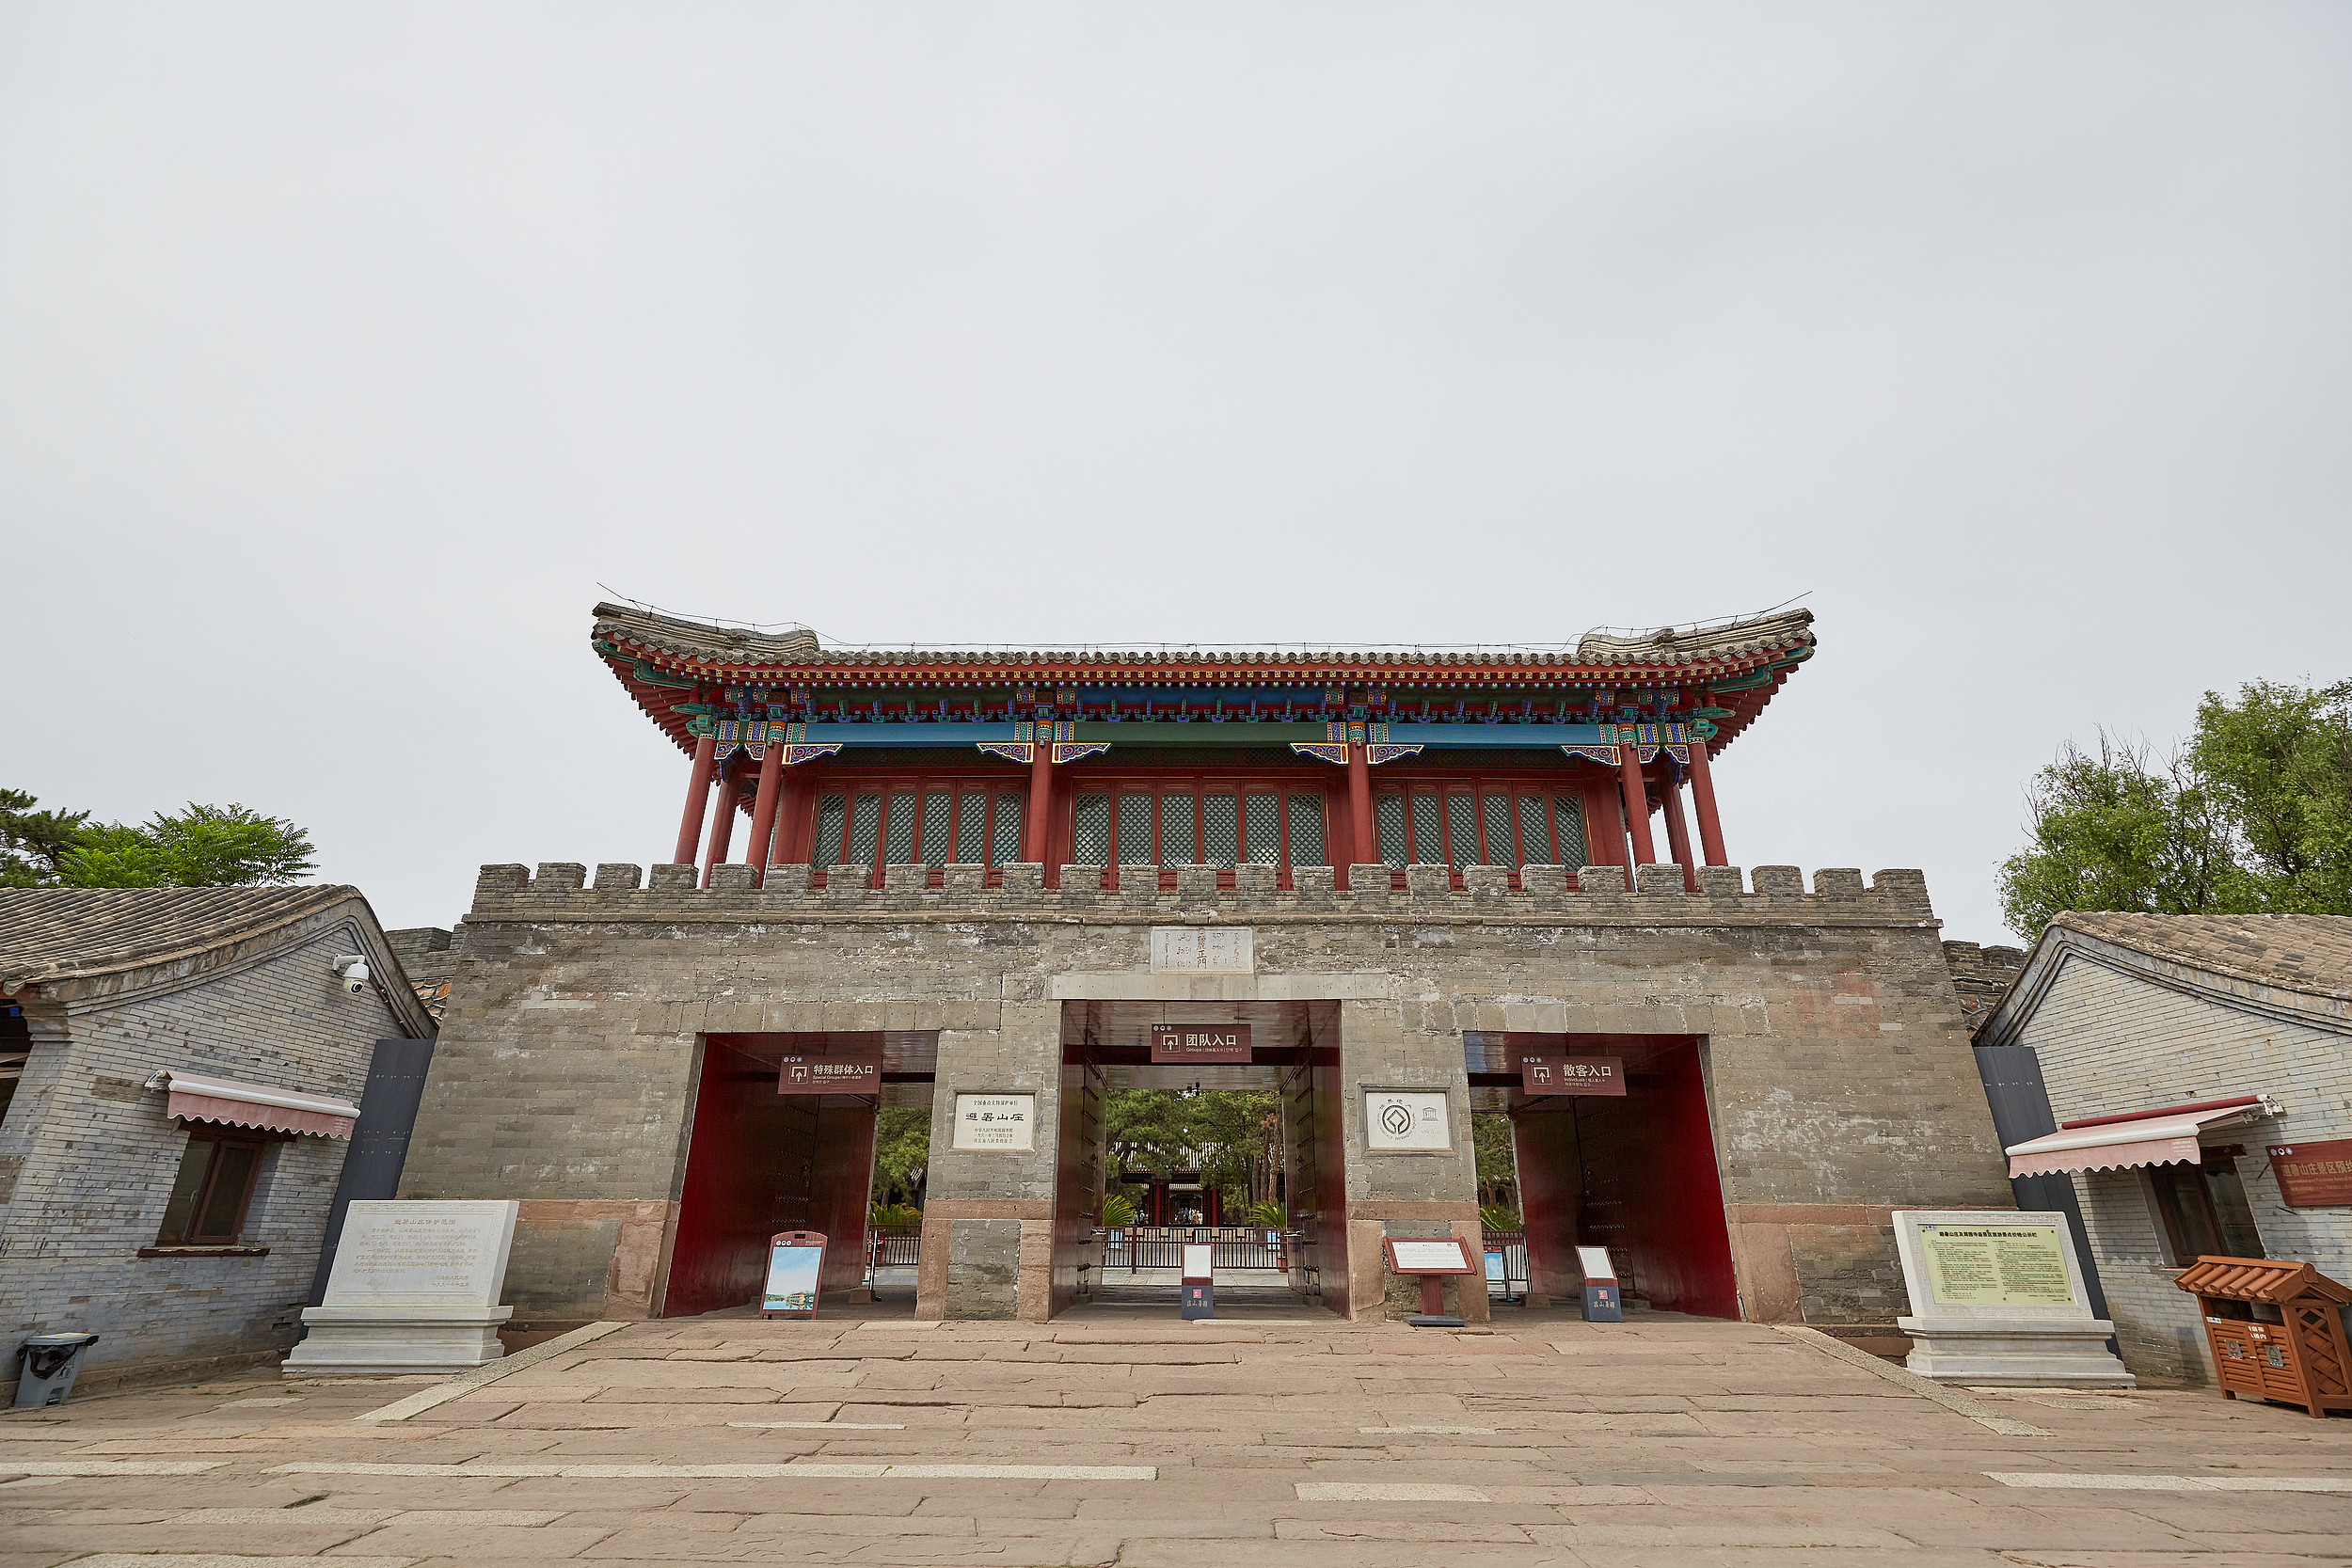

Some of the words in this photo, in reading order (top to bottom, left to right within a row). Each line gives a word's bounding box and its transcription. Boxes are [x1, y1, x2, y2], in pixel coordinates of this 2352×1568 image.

[1185, 1033, 1237, 1046] 团队入口
[813, 1064, 873, 1074] 特殊群体入口
[1563, 1064, 1612, 1077] 散客入口
[965, 1112, 1025, 1122] 避暑山庄
